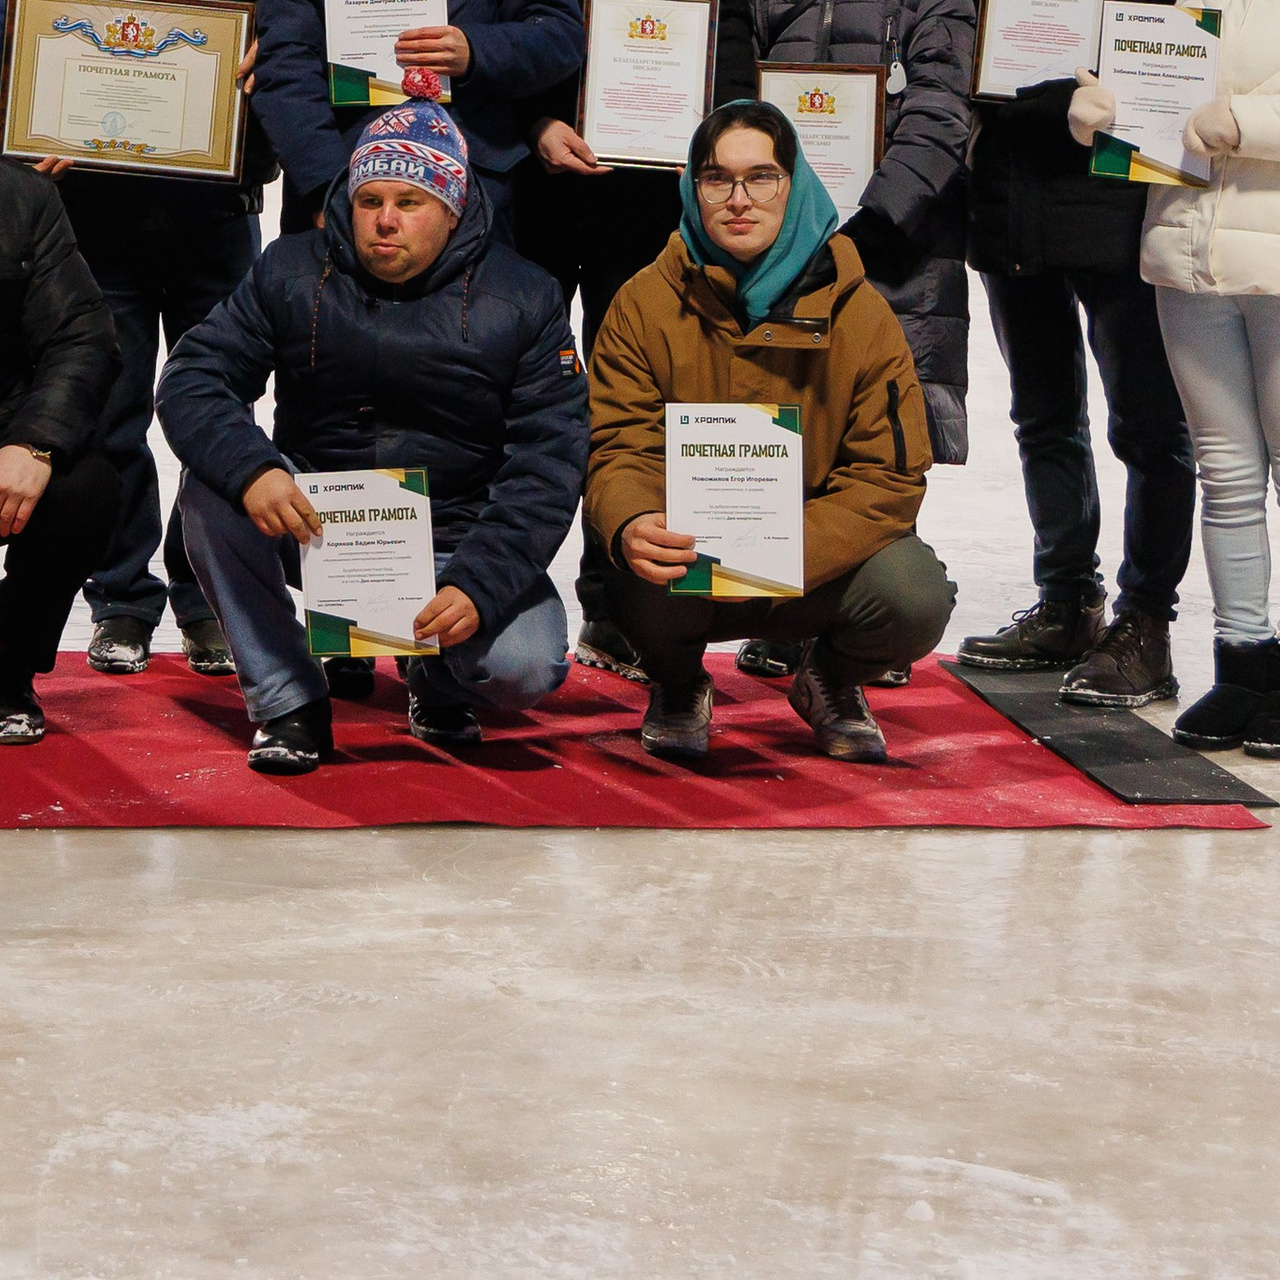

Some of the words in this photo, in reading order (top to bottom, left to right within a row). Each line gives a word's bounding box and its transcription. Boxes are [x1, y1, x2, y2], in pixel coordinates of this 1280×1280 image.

[1128, 15, 1165, 24] ХРОМПИК
[1114, 39, 1162, 54] ПОЧЕТНАЯ
[1165, 43, 1207, 58] ГРАМОТА
[78, 64, 130, 77] ПОЧЕТНАЯ
[132, 70, 177, 81] ГРАМОТА
[352, 158, 424, 180] ОМБАЙ
[681, 444, 735, 458] ПОЧЕТНАЯ
[739, 444, 789, 458] ГРАМОТА
[323, 484, 365, 492] ХРОМПИК
[368, 507, 417, 522] ГРАМОТА
